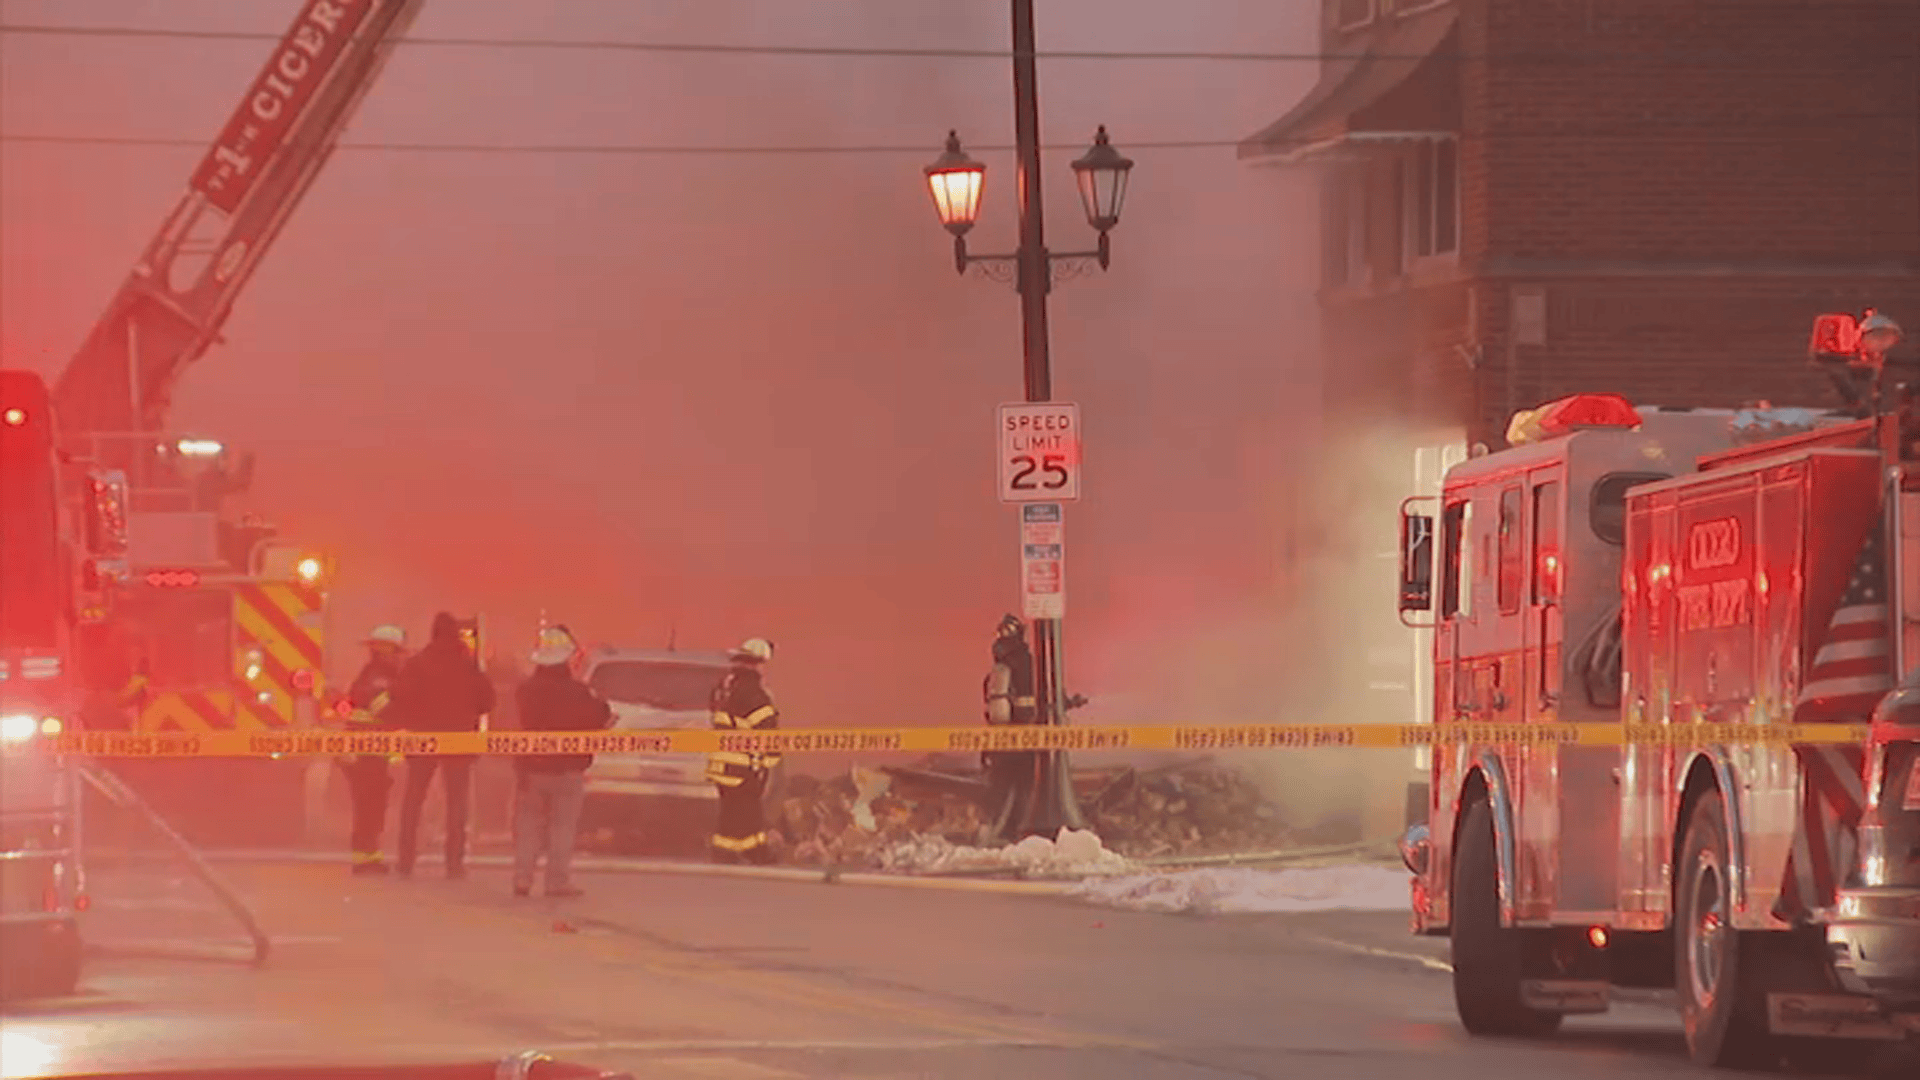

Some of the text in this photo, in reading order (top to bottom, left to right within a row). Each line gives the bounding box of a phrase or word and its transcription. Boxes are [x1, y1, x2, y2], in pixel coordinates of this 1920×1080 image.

[1006, 416, 1070, 430] SPEED
[1013, 436, 1062, 450] LIMIT
[1010, 455, 1068, 490] 25
[719, 734, 901, 750] CRIME SCENE DO NOT CROSS
[949, 730, 1128, 748] CRIME SCENE DO NOT CROSS
[1176, 728, 1353, 747] CRIME SCENE DO NOT CROSS
[1473, 726, 1489, 744] DO
[1494, 726, 1532, 744] SCENE
[1538, 726, 1578, 744] CRIME
[250, 736, 438, 753] CRIME SCENE DO NOT CROSS
[488, 737, 670, 752] CRIME SCENE DO NOT CROSS
